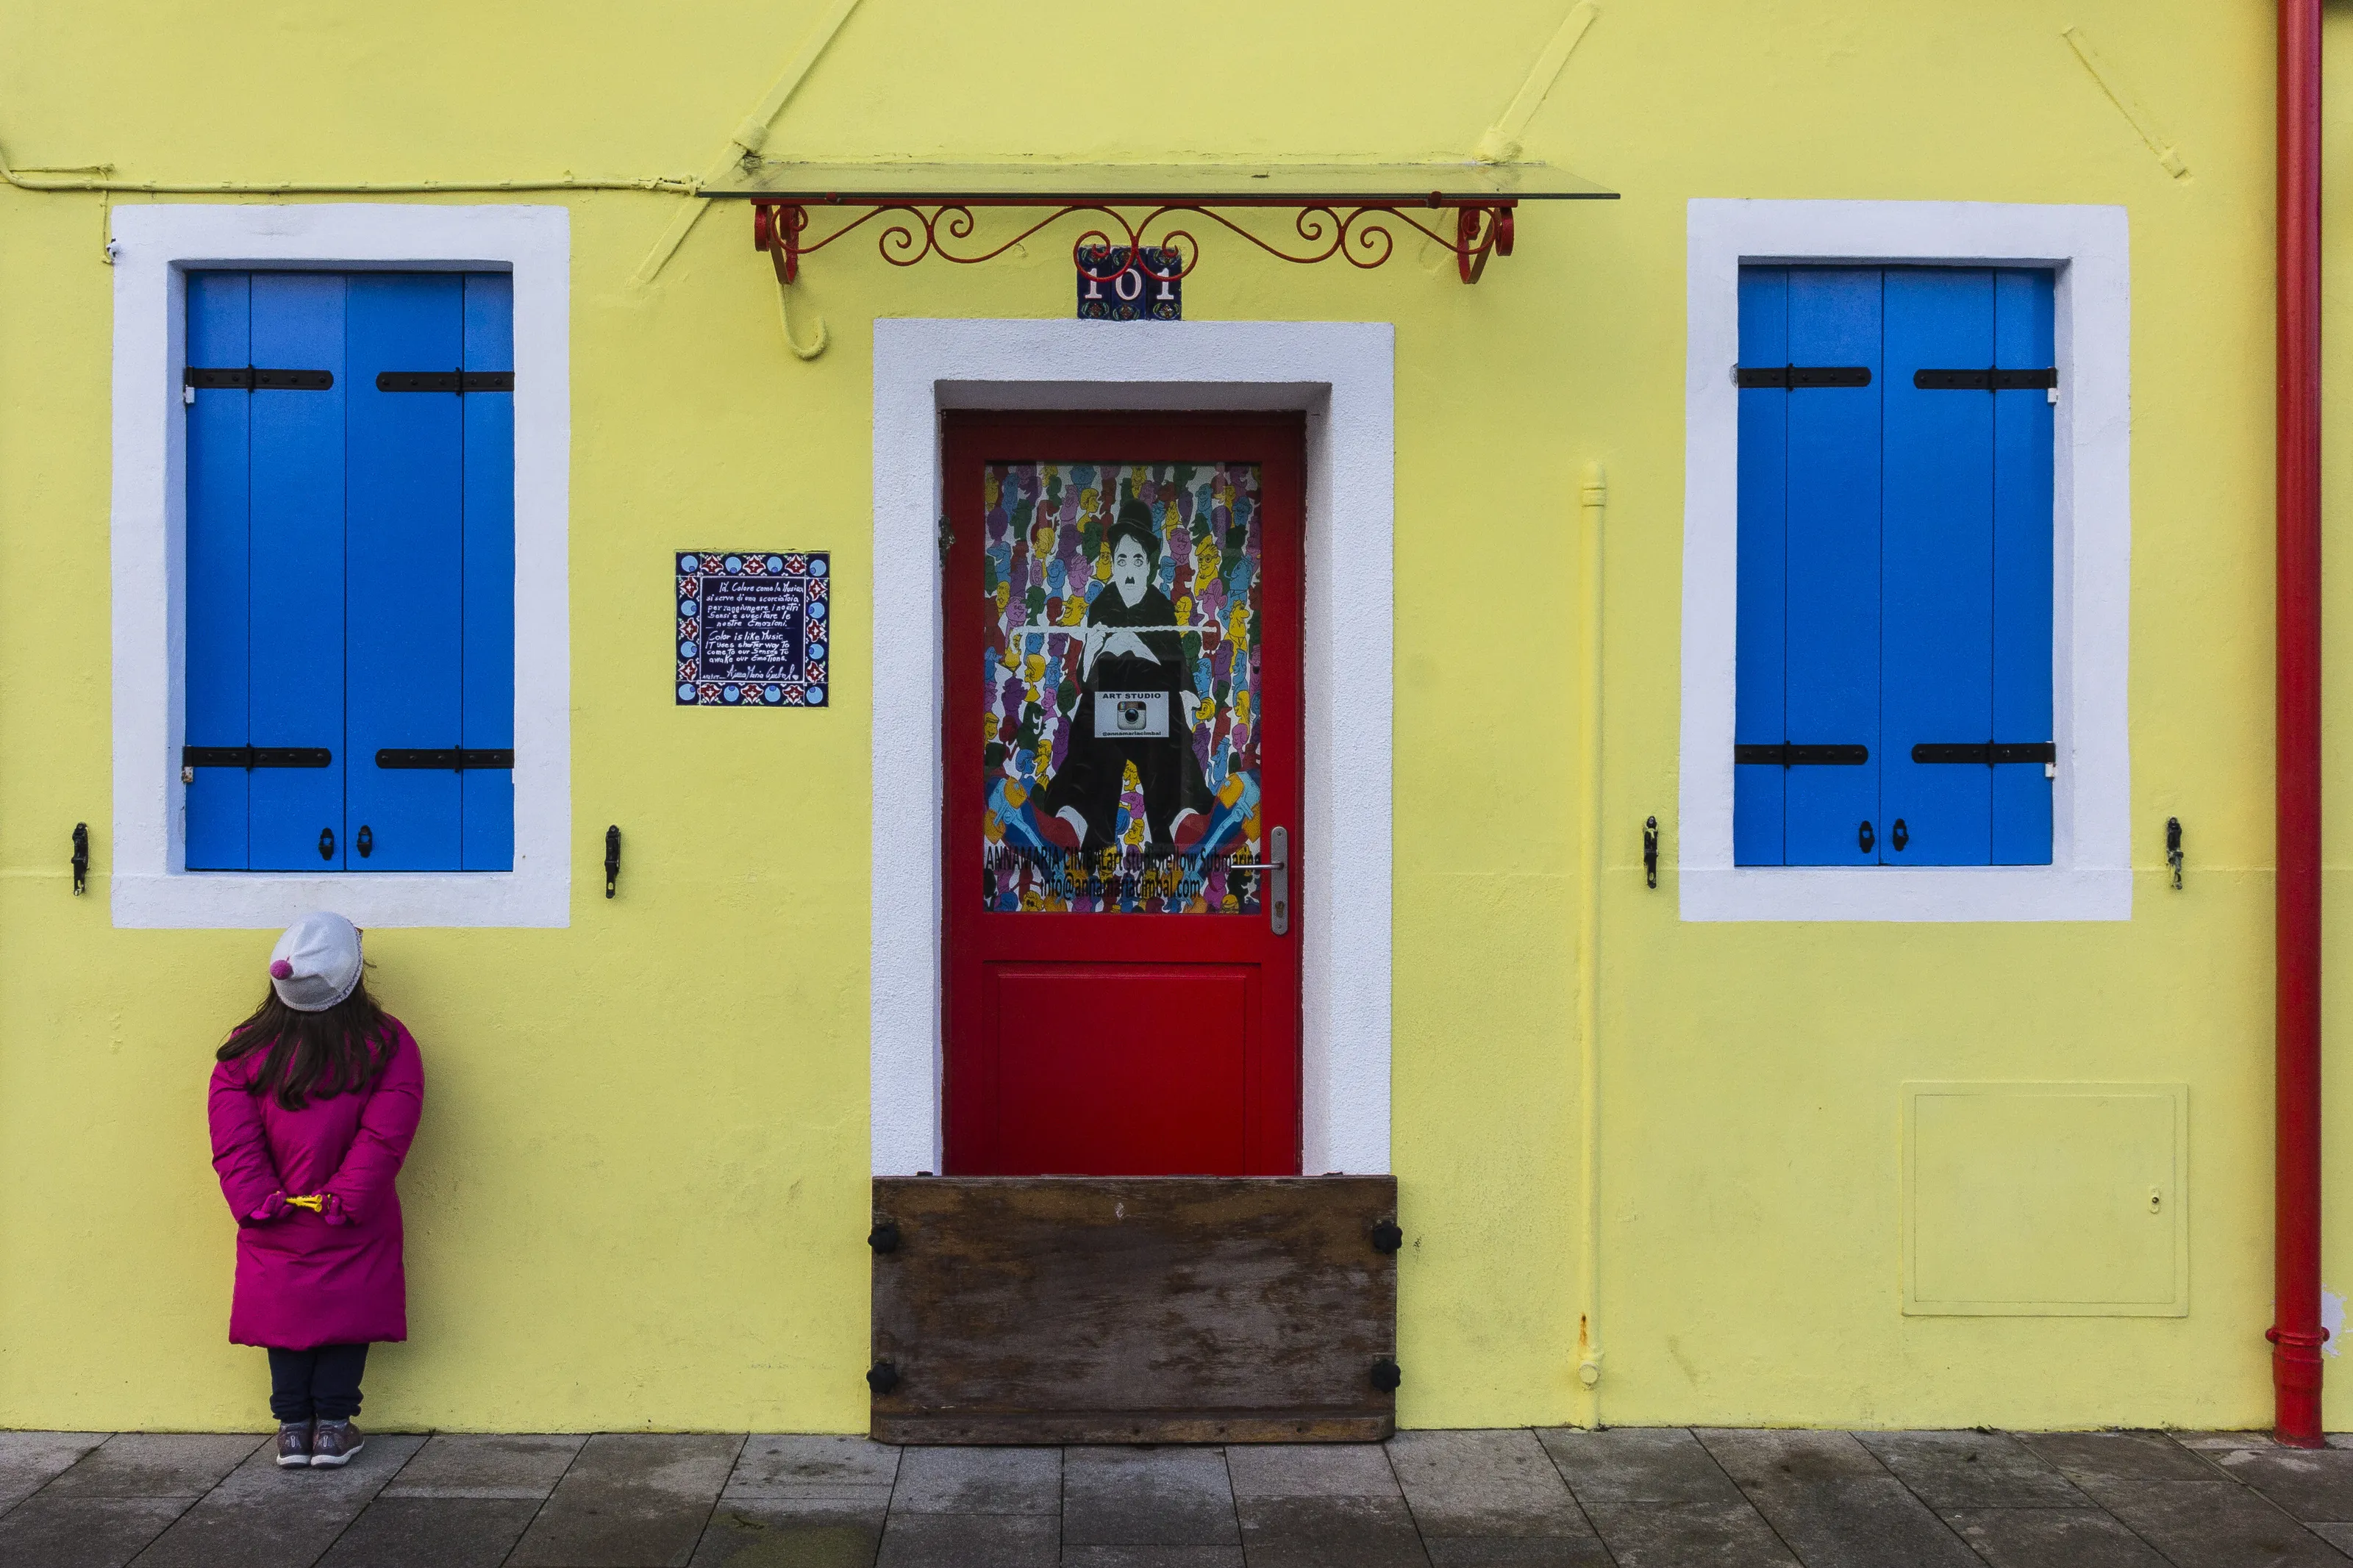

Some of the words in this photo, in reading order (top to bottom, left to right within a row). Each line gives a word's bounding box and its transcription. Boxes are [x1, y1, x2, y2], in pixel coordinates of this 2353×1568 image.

[1085, 268, 1174, 301] 101
[732, 581, 754, 592] Colore
[736, 593, 744, 602] di
[781, 610, 791, 620] le
[708, 630, 732, 641] Color
[734, 632, 743, 641] is
[985, 846, 1061, 871] ANNAMARIA
[1040, 872, 1201, 901] info@annamariacimbal.com
